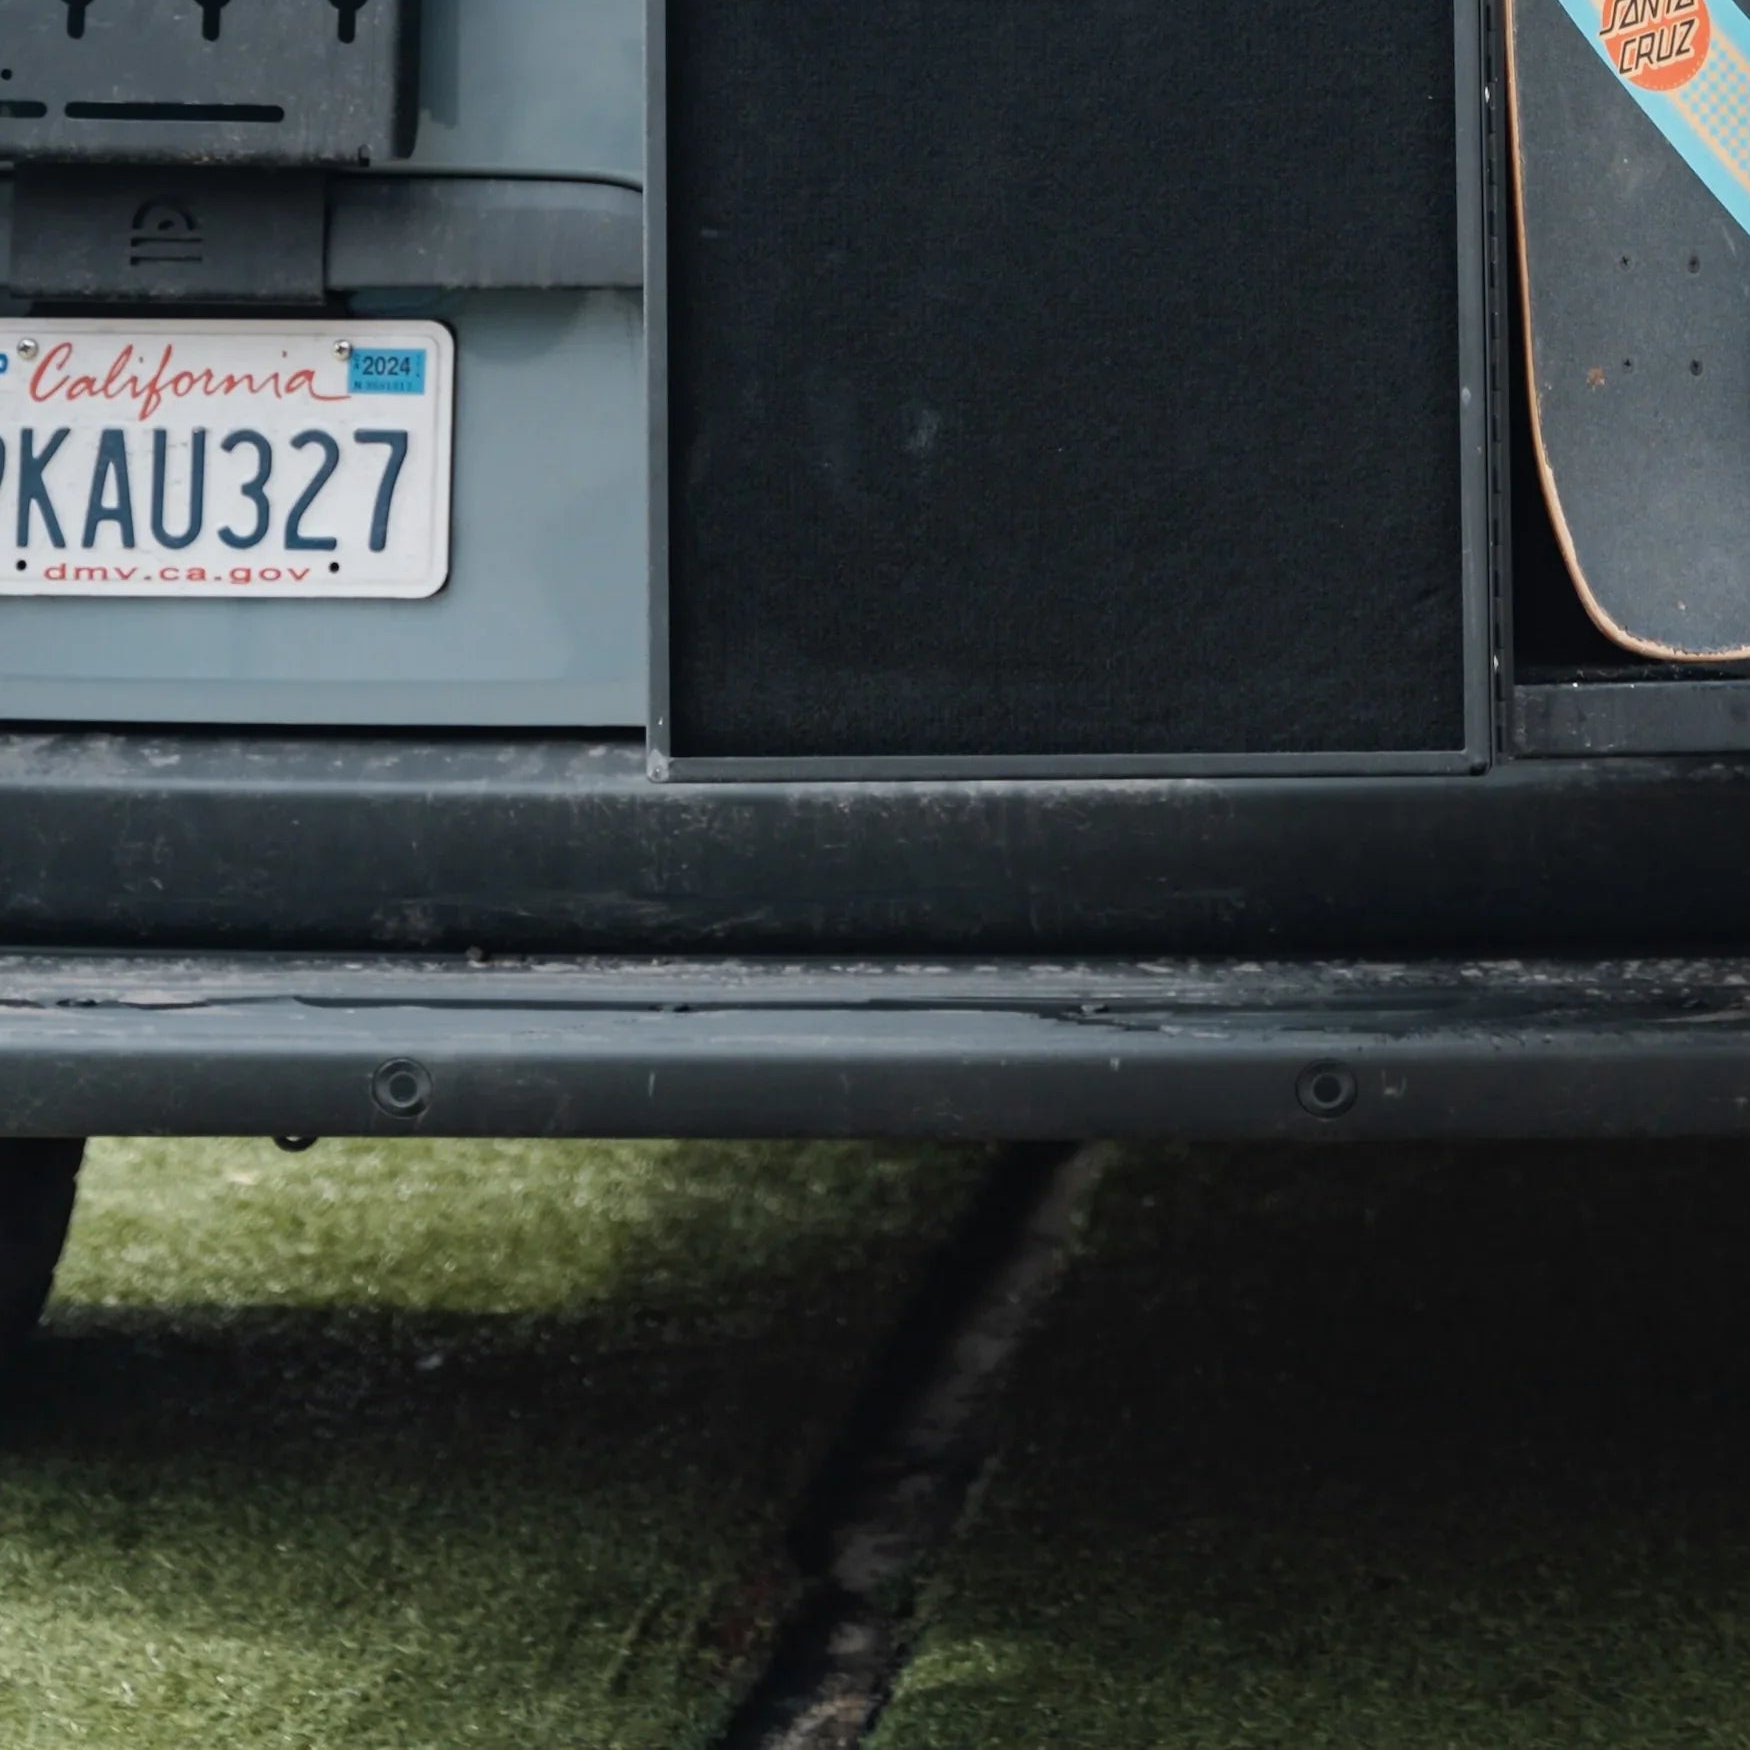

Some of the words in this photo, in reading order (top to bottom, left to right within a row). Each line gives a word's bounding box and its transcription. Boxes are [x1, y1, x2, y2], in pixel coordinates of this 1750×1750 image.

[1619, 18, 1696, 75] CRUZ
[28, 342, 352, 421] California
[361, 355, 411, 376] 2024
[43, 562, 311, 584] dmv.ca.gov
